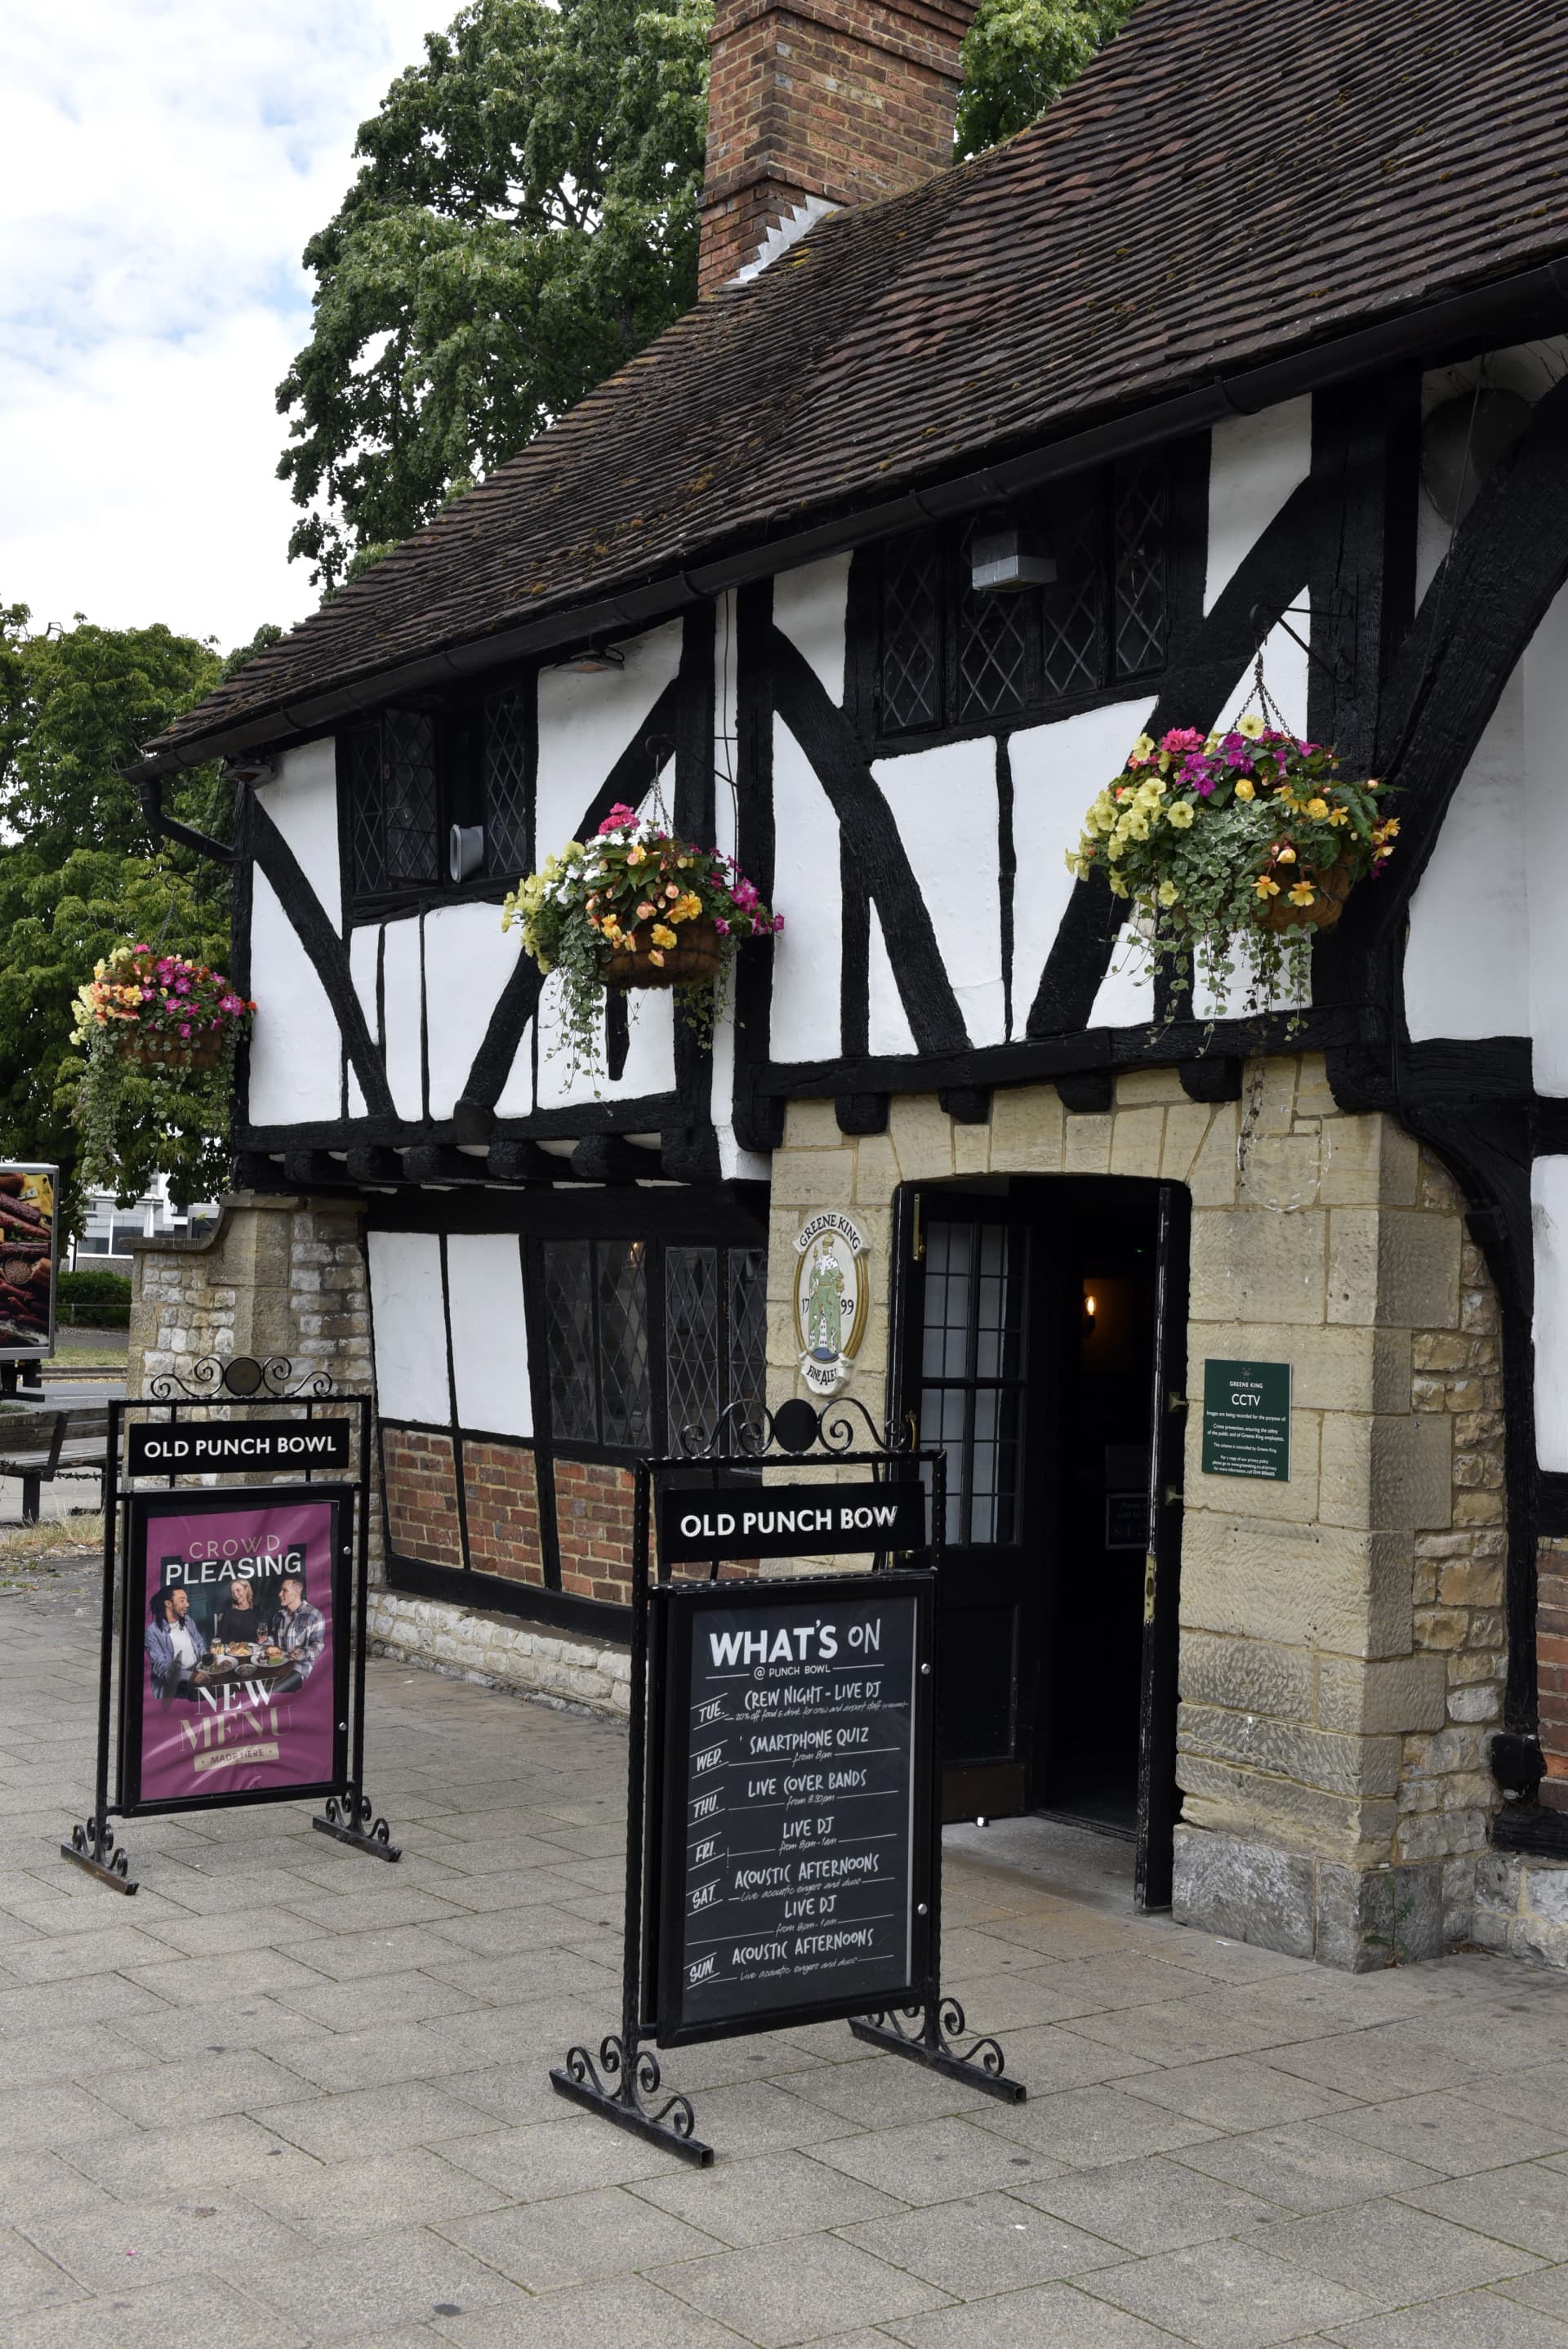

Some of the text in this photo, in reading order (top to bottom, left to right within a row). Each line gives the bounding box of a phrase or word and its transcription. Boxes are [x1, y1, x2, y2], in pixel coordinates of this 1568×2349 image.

[800, 1215, 861, 1250] GREENE KING
[801, 1298, 854, 1315] 17 99
[806, 1365, 837, 1386] FINE ALES
[1232, 1393, 1261, 1406] CCTV
[144, 1434, 336, 1458] OLD PUNCH BOWL
[680, 1505, 898, 1537] OLD PUNCH BOW
[189, 1535, 281, 1559] CROWD
[166, 1552, 301, 1586] PLEASING
[709, 1618, 880, 1666] WHAT'S ON
[754, 1664, 831, 1680] @ PUNCH BOWL
[194, 1677, 278, 1715] NEW
[745, 1687, 779, 1711] CREW
[784, 1685, 823, 1707] NIGHT
[835, 1682, 862, 1700] LIVE
[866, 1681, 881, 1698] DJ
[699, 1702, 725, 1723] TUE.
[761, 1708, 778, 1722] food
[178, 1705, 294, 1752] MENU
[750, 1727, 869, 1754] SMARTPHONE QUIZ
[210, 1749, 264, 1765] MADE HERE
[697, 1749, 722, 1772] WED.
[791, 1749, 833, 1767] from 8pm
[748, 1769, 867, 1798] LIVE COVER BANDS
[693, 1795, 719, 1818] THU.
[786, 1795, 806, 1812] from
[783, 1816, 835, 1839] LIVE DJ
[695, 1841, 716, 1863] FRI.
[778, 1841, 797, 1856] from
[735, 1853, 880, 1889] ACOUSTIC AFTERNOONS
[693, 1885, 716, 1909] SAT.
[741, 1892, 760, 1901] Live
[761, 1883, 795, 1898] acoustic
[823, 1879, 840, 1889] and
[785, 1895, 837, 1919] LIVE DJ
[775, 1923, 795, 1937] from
[732, 1928, 875, 1965] ACOUSTIC AFTERNOONS
[689, 1957, 714, 1982] SUN.
[741, 1972, 757, 1981] Live
[759, 1964, 791, 1978] acoustic
